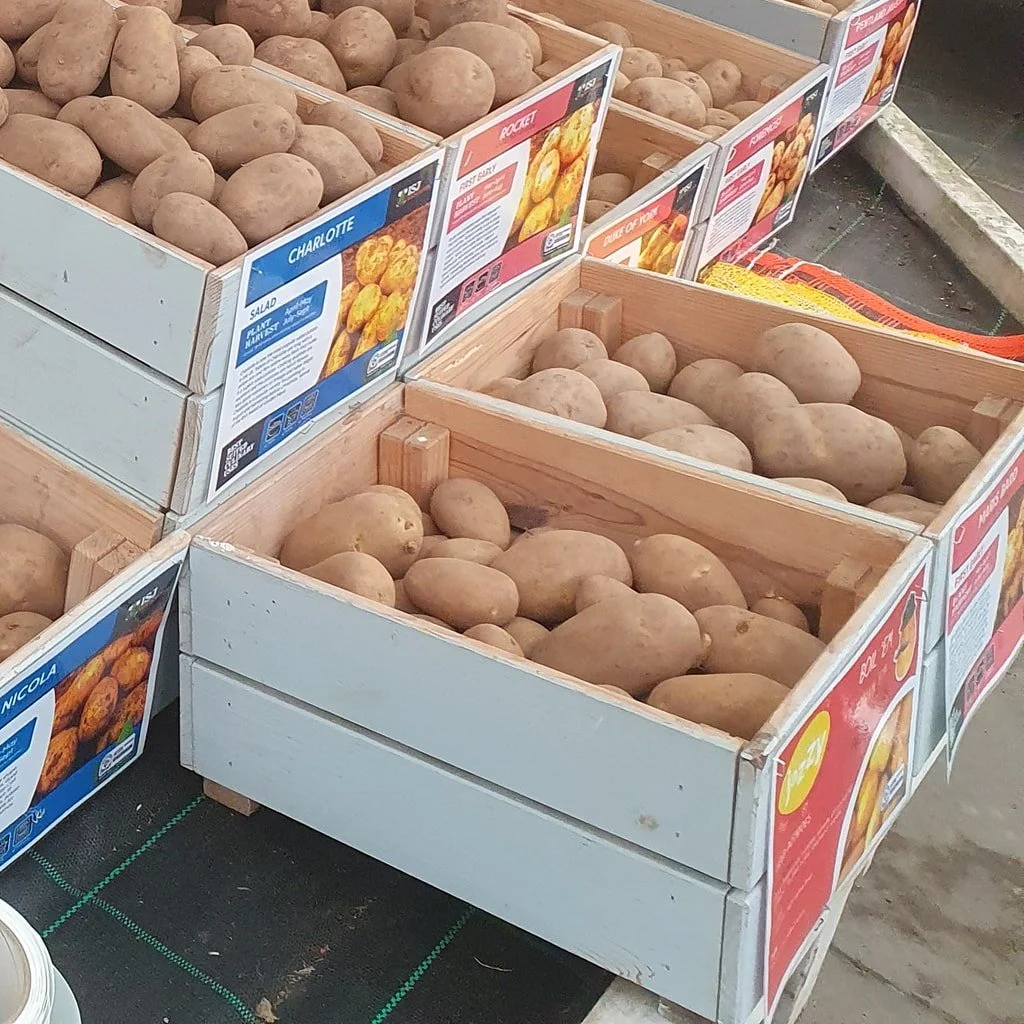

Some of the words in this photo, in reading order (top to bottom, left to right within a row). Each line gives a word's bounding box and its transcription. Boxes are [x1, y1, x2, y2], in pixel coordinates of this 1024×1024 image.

[499, 109, 538, 141] ROCKET
[408, 180, 422, 196] ISJ
[288, 216, 355, 264] CHARLOTTE
[603, 228, 626, 248] DUKE
[625, 218, 639, 234] OF
[250, 297, 276, 320] SALAD
[245, 321, 280, 349] HARVEST
[246, 317, 272, 339] PLANT
[978, 491, 1000, 529] MARIS
[1, 664, 56, 714] NICOLA
